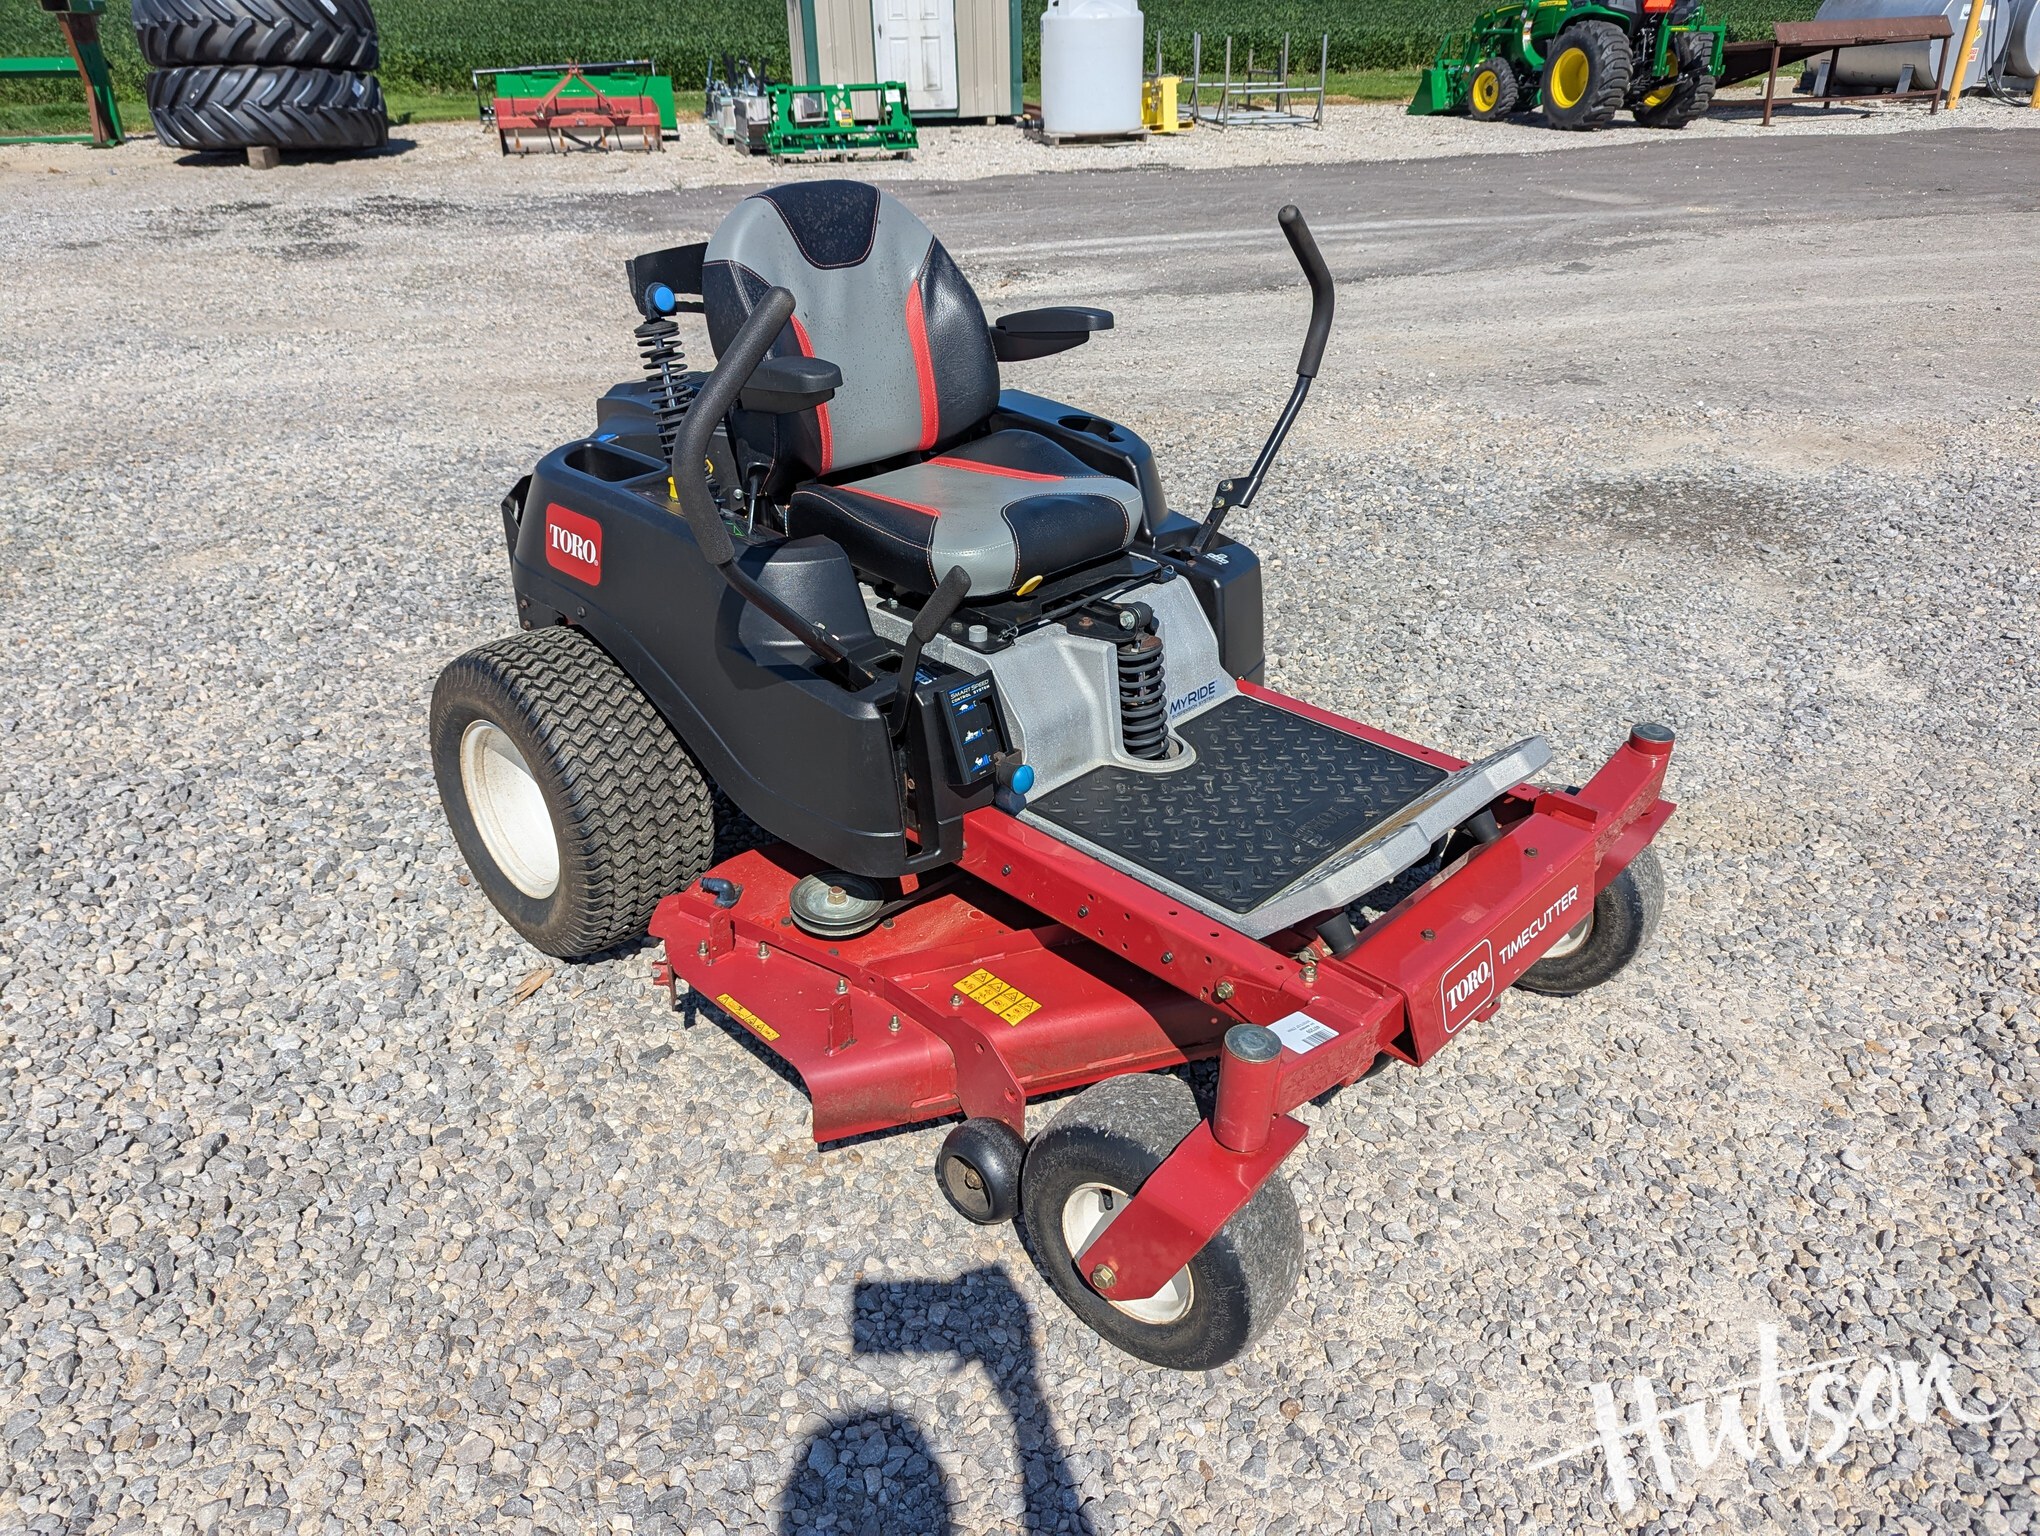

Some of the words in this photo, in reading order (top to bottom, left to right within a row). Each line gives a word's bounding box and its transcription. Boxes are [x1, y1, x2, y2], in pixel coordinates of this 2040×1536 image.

[549, 523, 597, 564] TORO
[950, 687, 971, 699] SMART
[970, 679, 989, 691] SPEED
[951, 693, 971, 703] CONTROL
[973, 685, 990, 694] SYSTEM
[1171, 704, 1198, 719] SUSPENSION
[1198, 695, 1214, 705] SYSTEM
[1498, 886, 1578, 964] TIMECUTTER
[1446, 961, 1489, 1012] TORO
